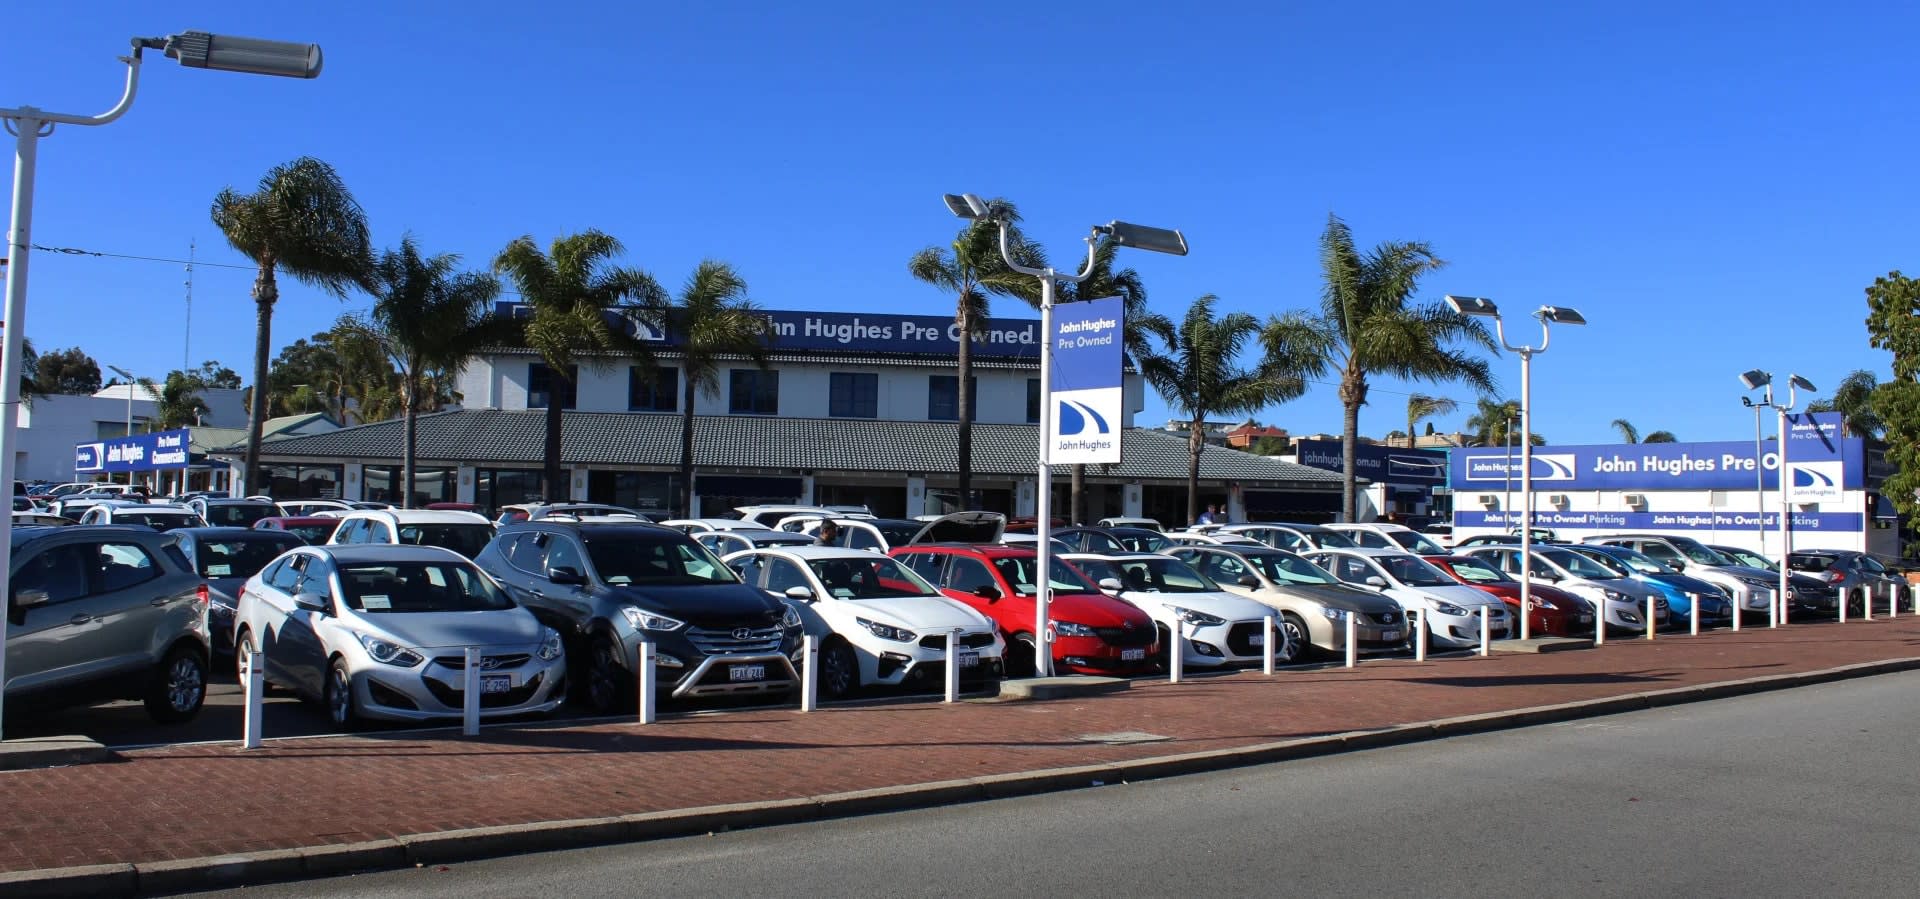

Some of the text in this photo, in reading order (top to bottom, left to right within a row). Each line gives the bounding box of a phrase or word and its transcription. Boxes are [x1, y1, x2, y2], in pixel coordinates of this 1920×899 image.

[805, 318, 893, 343] Hughes
[901, 321, 938, 340] Pre
[1059, 317, 1116, 334] John Hughes
[1058, 331, 1112, 349] Pre Owned
[107, 445, 121, 462] John
[121, 442, 144, 465] Hughes
[1058, 439, 1112, 452] John Hughes
[1304, 450, 1382, 469] johnhughom.au
[1473, 463, 1493, 472] John
[1593, 456, 1637, 473] John
[1642, 454, 1716, 476] Hughes
[1721, 453, 1756, 471] Pre
[1483, 514, 1503, 523] John
[1537, 514, 1553, 523] Pre
[1553, 513, 1587, 524] Owned
[1588, 514, 1625, 526] Parking
[1652, 515, 1676, 525] John
[1676, 515, 1713, 527] Hughes
[1715, 515, 1732, 525] Pre
[1734, 515, 1774, 525] Ownd
